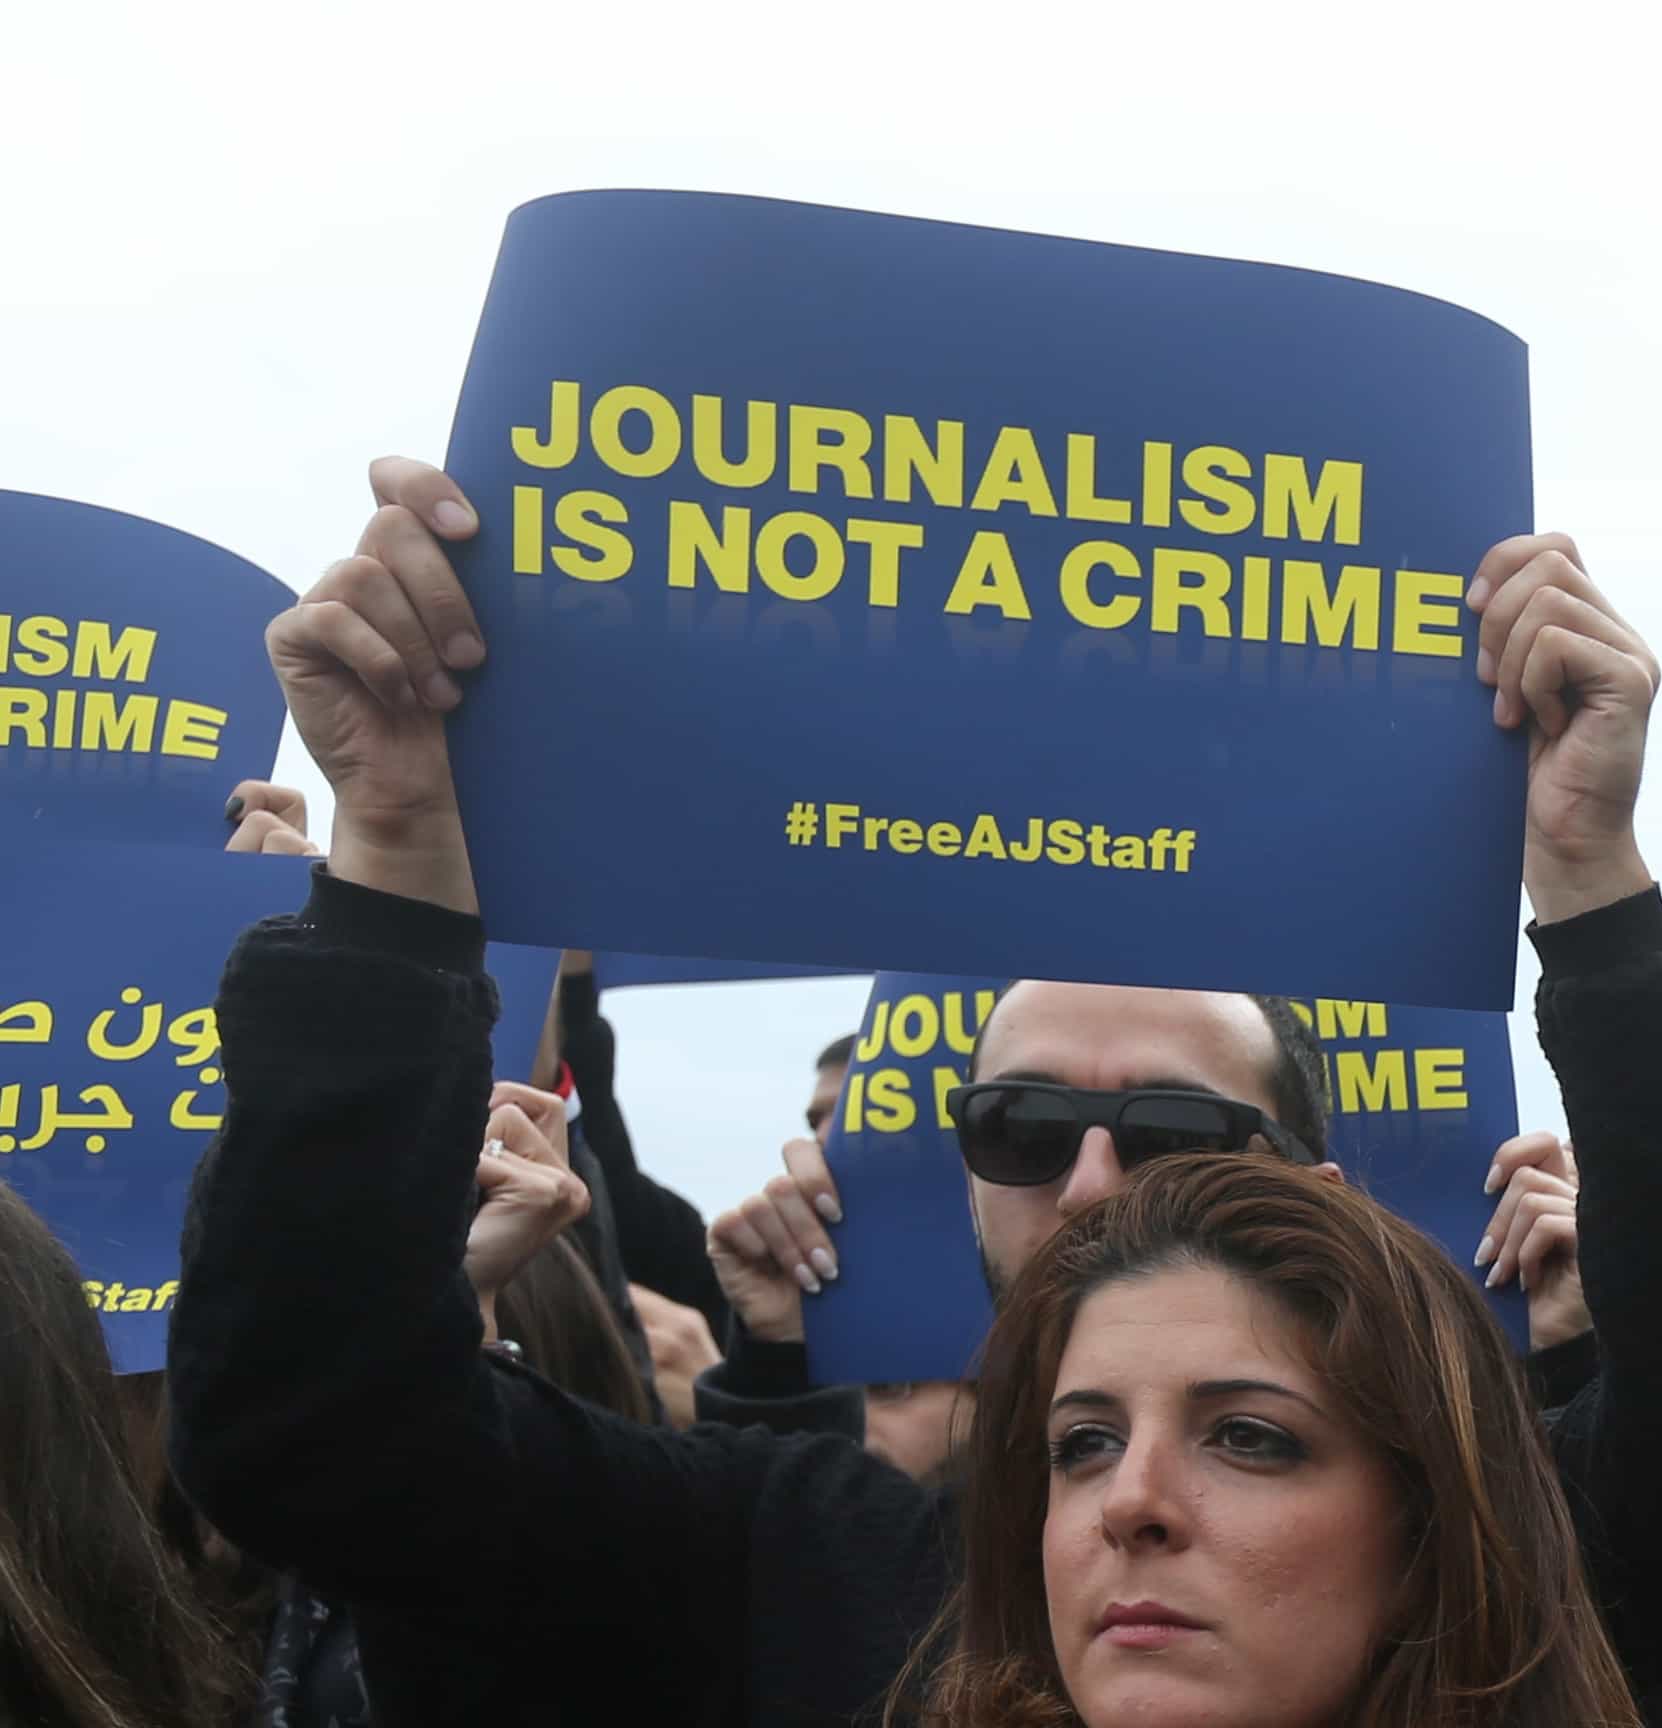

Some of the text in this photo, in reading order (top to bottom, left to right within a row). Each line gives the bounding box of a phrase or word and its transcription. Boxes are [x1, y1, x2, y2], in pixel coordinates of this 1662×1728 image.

[512, 381, 1363, 544] JOURNALISM
[514, 486, 1464, 656] IS NOT A CRIME
[0, 687, 227, 758] RIME
[786, 803, 1195, 872] #FreeAJStaff
[845, 1069, 916, 1132] IS
